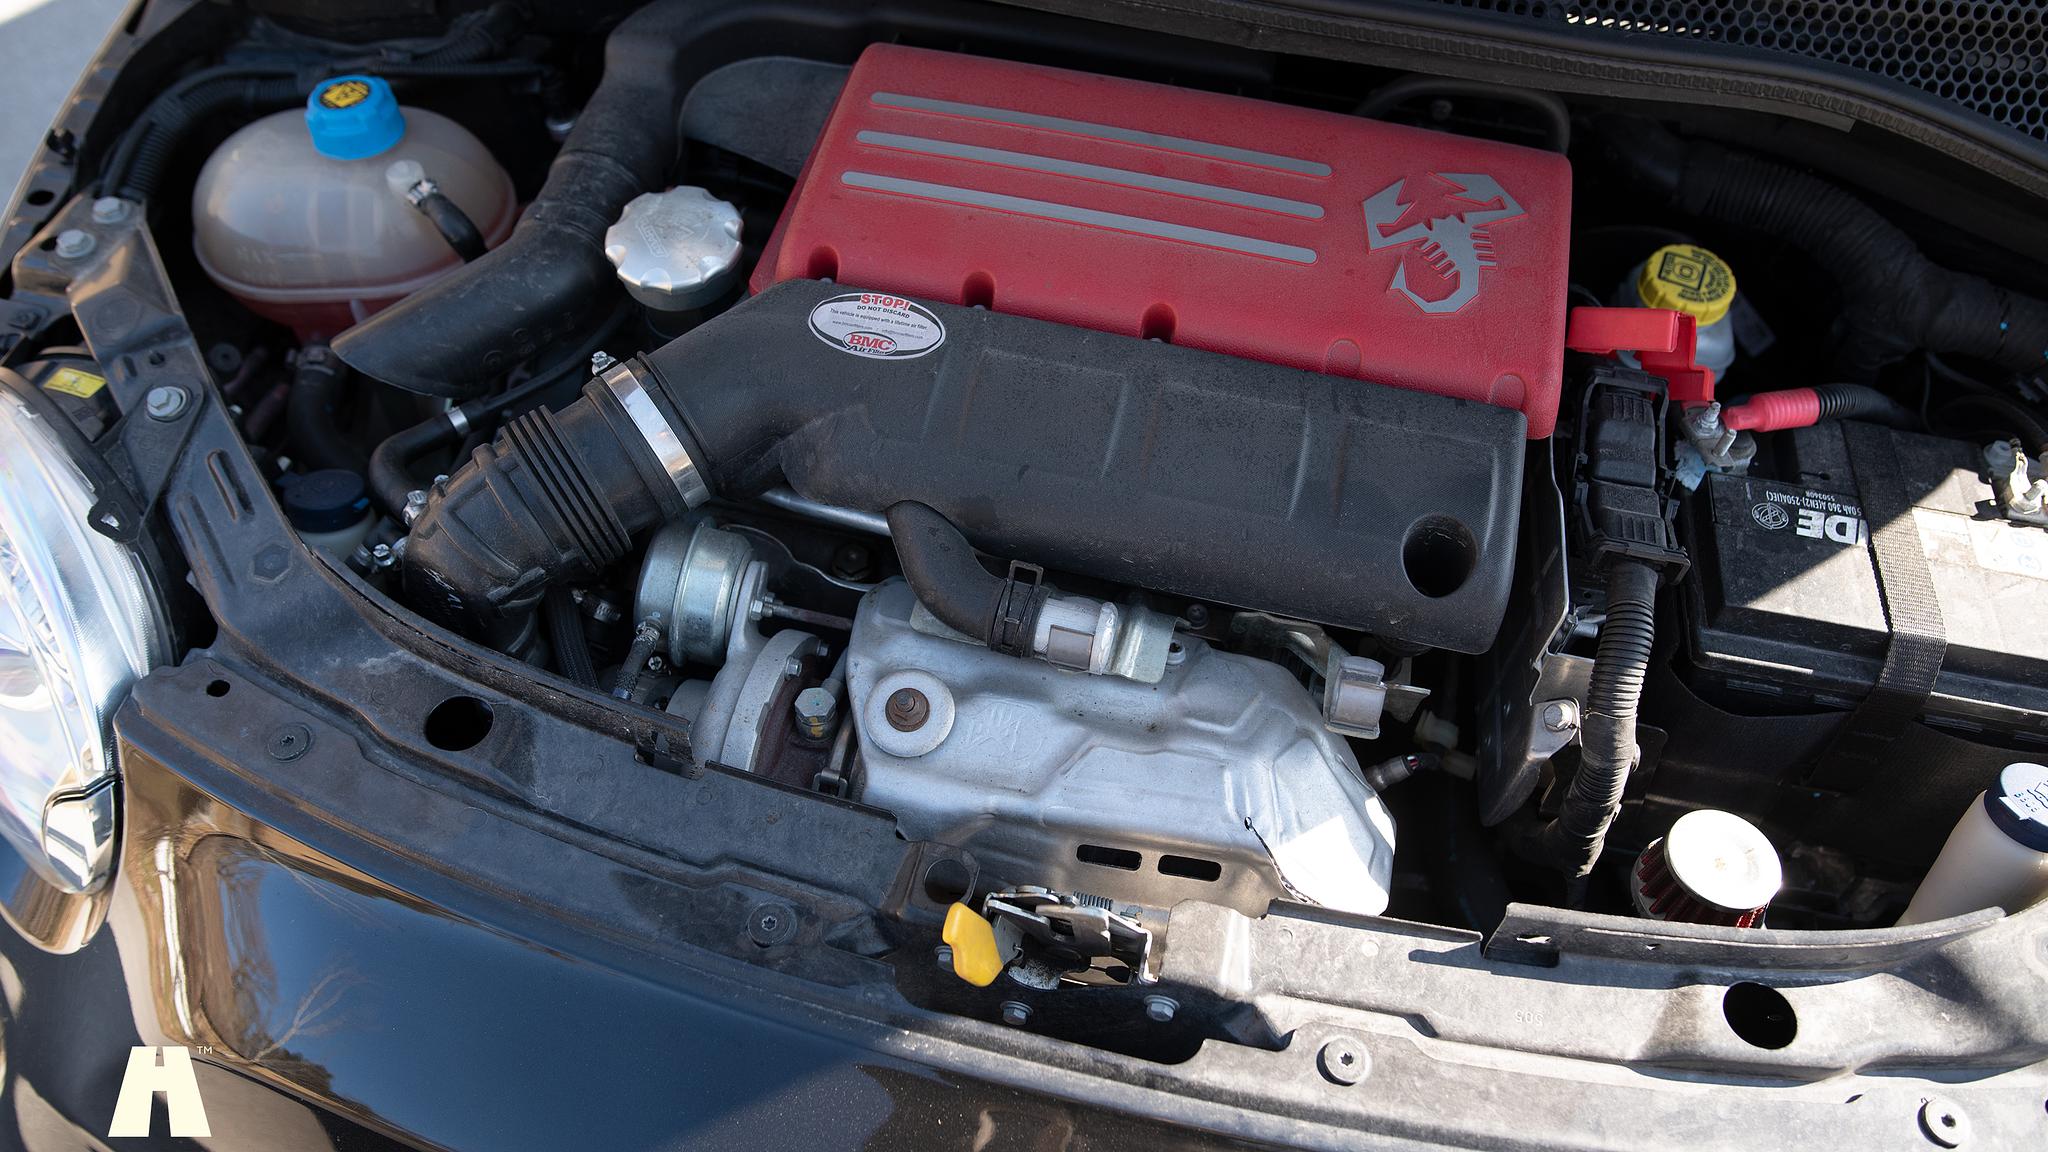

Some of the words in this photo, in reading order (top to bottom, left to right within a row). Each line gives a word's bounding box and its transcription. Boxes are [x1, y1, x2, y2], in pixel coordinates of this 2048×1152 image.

[860, 293, 911, 311] STOP!
[883, 307, 910, 320] DISCARD
[849, 334, 893, 350] BMC
[1827, 502, 1842, 513] 360
